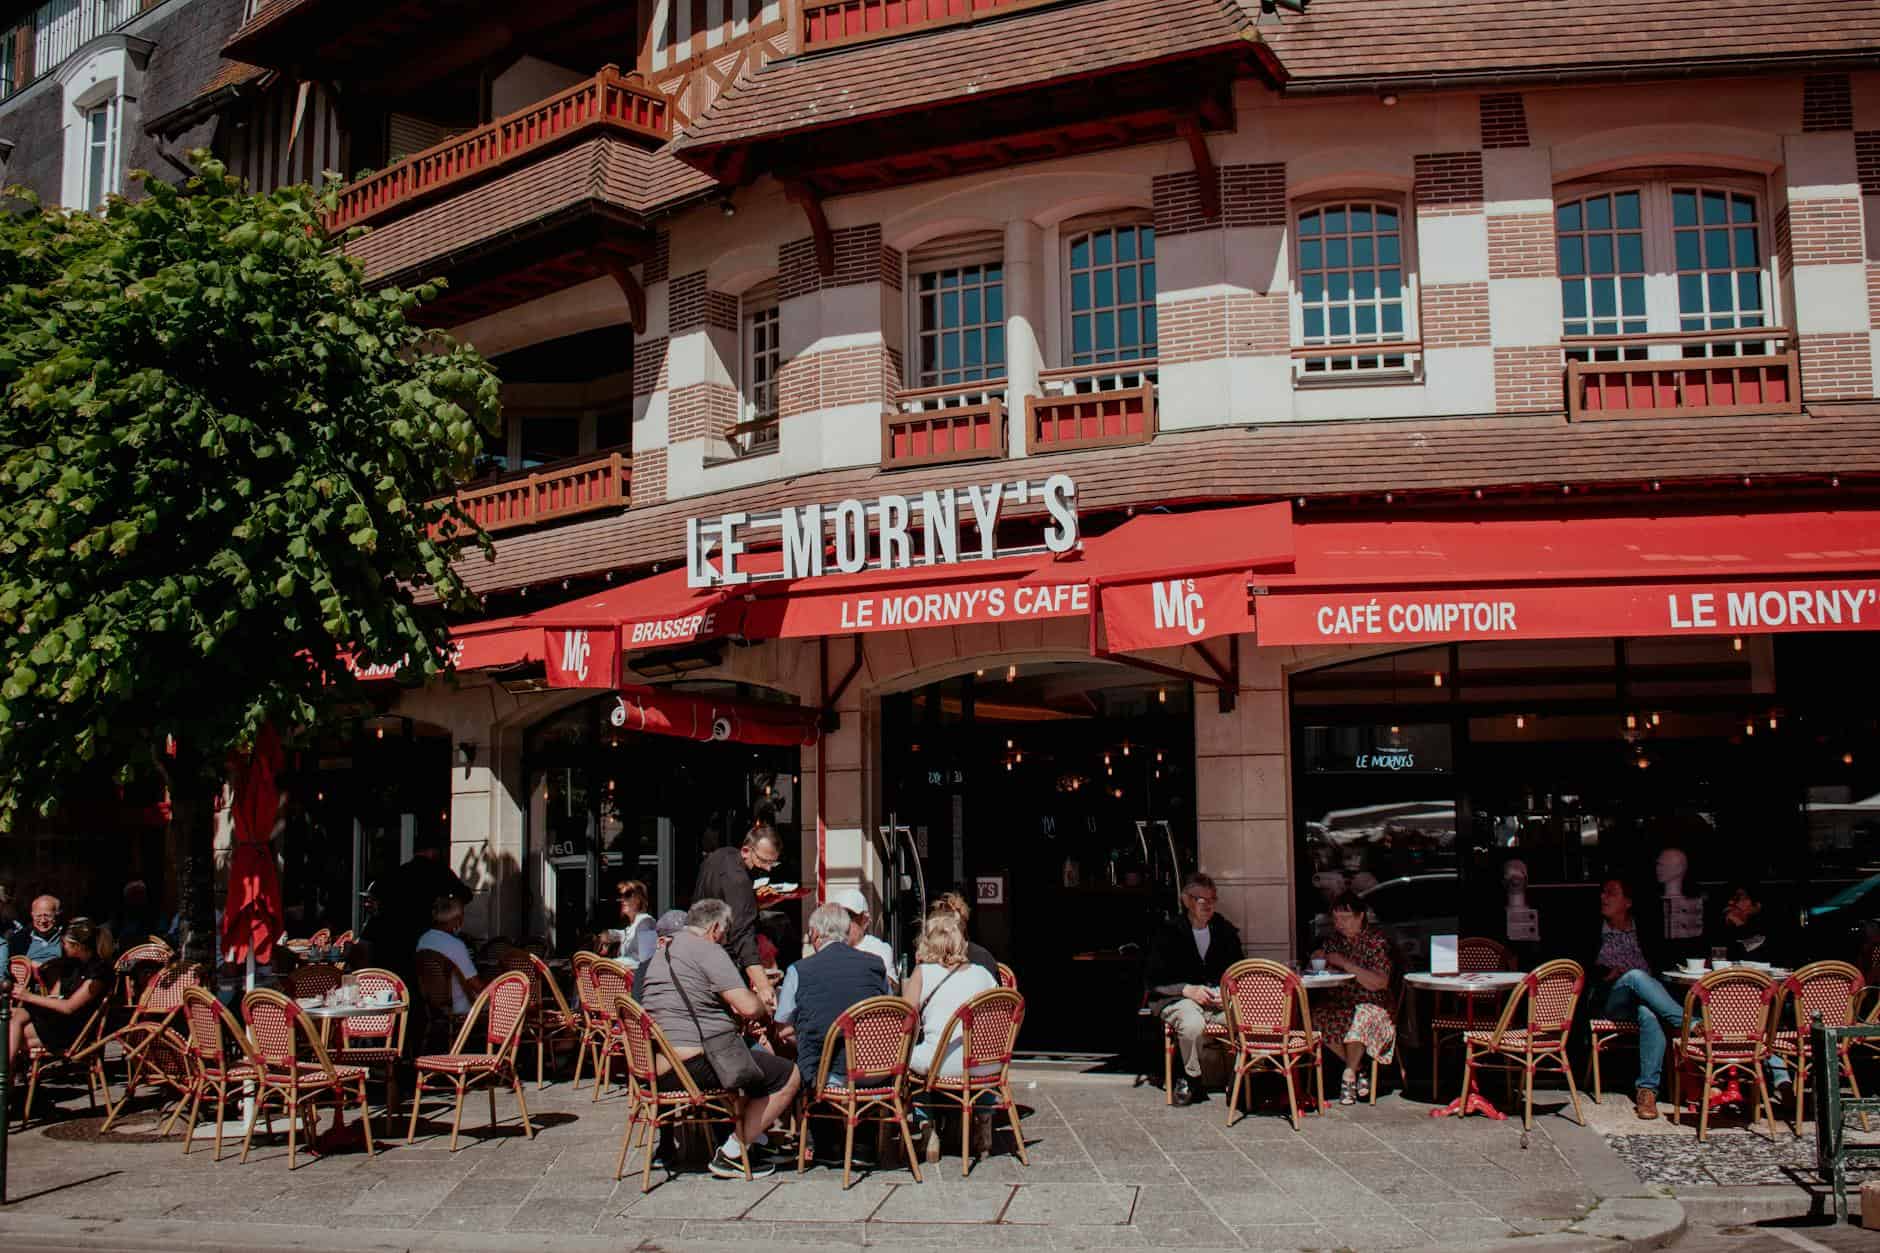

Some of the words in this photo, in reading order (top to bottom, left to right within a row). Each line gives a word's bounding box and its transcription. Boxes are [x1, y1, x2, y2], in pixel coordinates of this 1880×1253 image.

[686, 512, 749, 588] LE
[782, 474, 1079, 578] MORNY'S
[631, 613, 716, 643] BRASSERIE
[840, 599, 873, 628] LE
[881, 588, 1006, 625] MORNY'S
[1317, 598, 1382, 634] CAFÉ
[1388, 602, 1517, 632] COMPTOIR
[1669, 593, 1717, 628] LE
[1726, 588, 1880, 627] MORNY'
